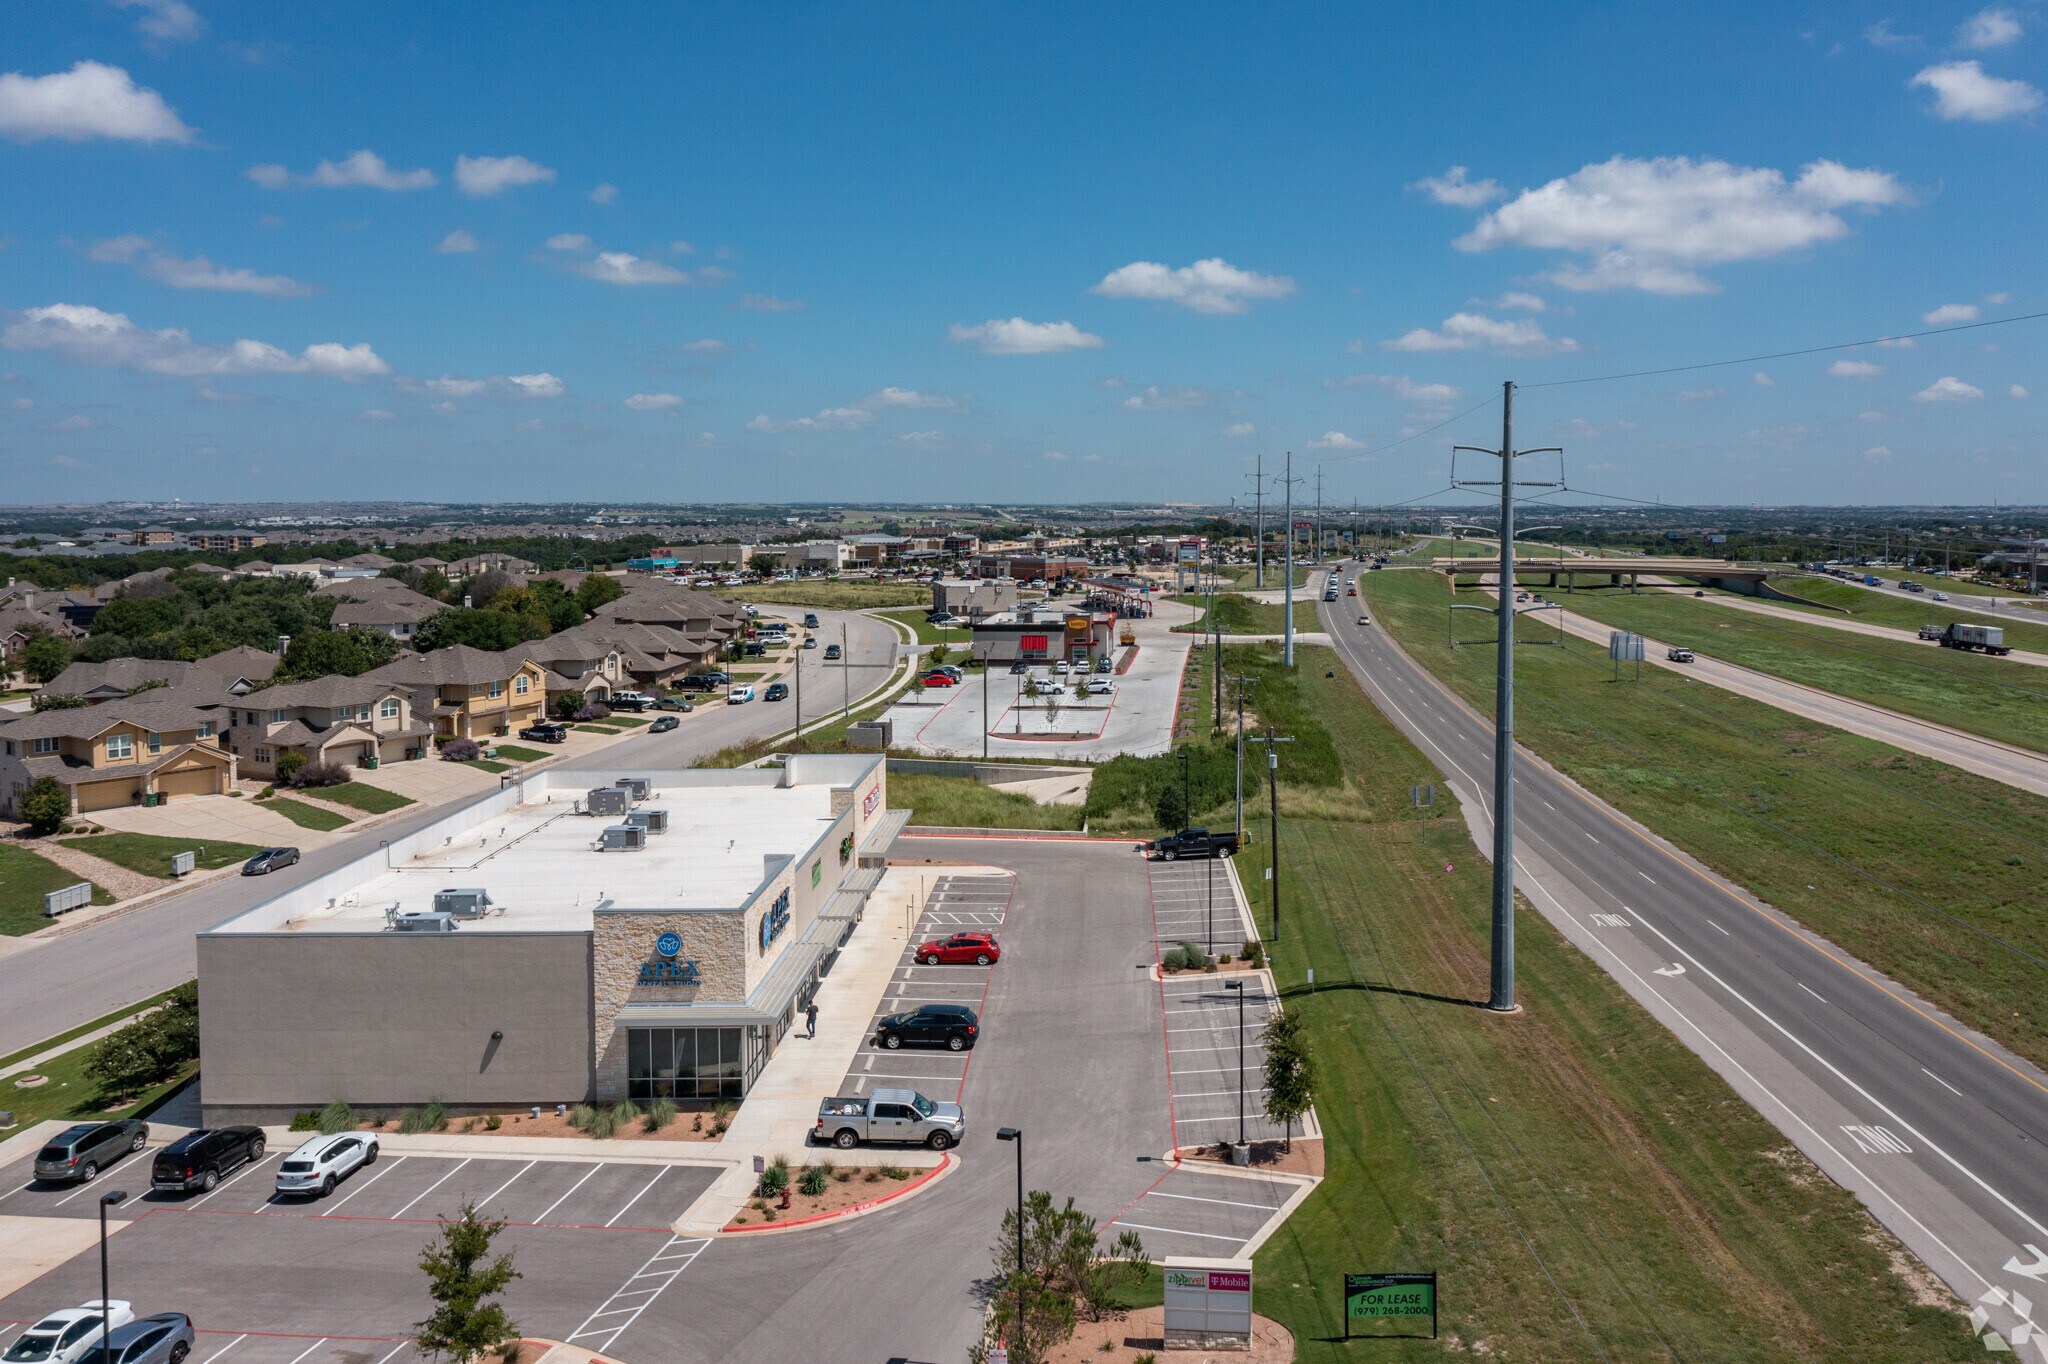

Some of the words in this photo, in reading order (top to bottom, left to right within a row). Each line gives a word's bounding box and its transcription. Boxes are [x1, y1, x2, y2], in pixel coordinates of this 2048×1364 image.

[1589, 913, 1632, 927] ONLY
[639, 960, 702, 977] APEX
[1838, 1124, 1905, 1150] ONLY
[1360, 1294, 1384, 1305] FOR
[1388, 1294, 1422, 1304] LEASE
[1354, 1306, 1379, 1317] (979)
[1382, 1306, 1428, 1315] 268-2000
